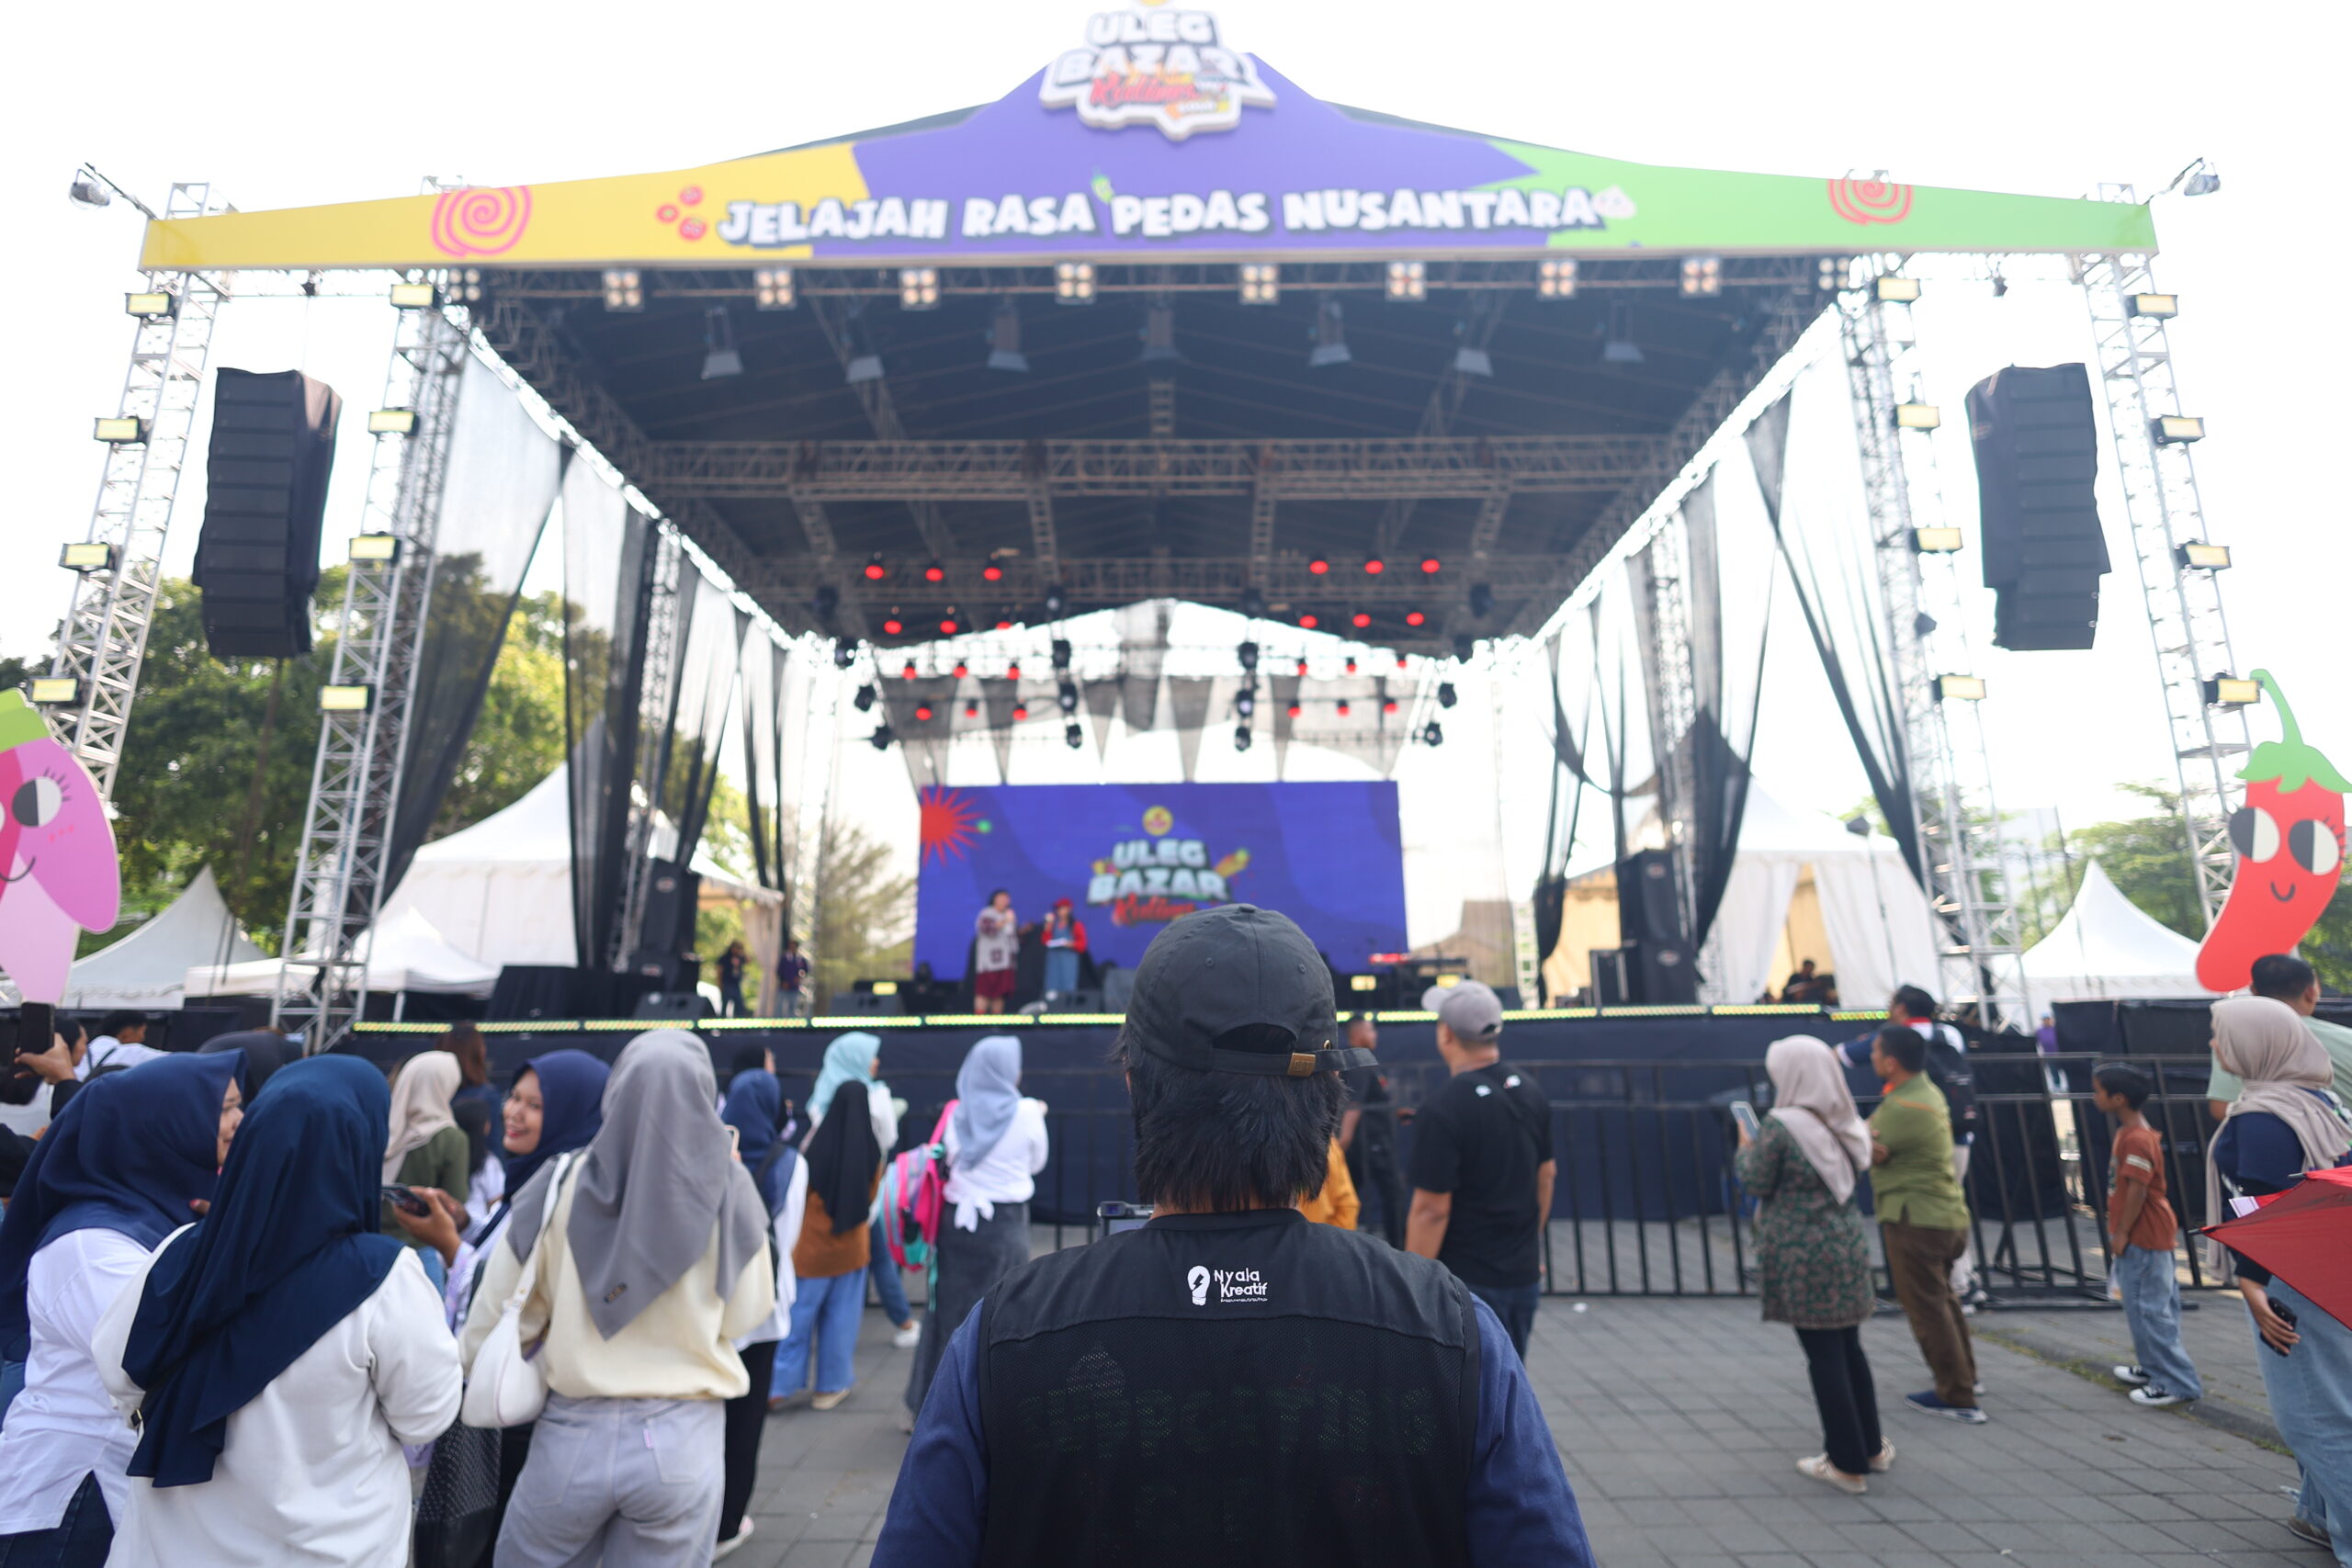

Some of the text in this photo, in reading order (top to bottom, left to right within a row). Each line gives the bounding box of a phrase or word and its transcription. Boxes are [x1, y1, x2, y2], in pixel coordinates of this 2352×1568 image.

[1090, 11, 1214, 45] ULEG
[717, 188, 1600, 243] JELAJAH RASA PEDAS NUSANTARA
[1112, 839, 1206, 868] ULEG
[1087, 867, 1229, 903] BAZAR
[1214, 1268, 1261, 1283] Nyala
[1220, 1282, 1268, 1298] Kreatif
